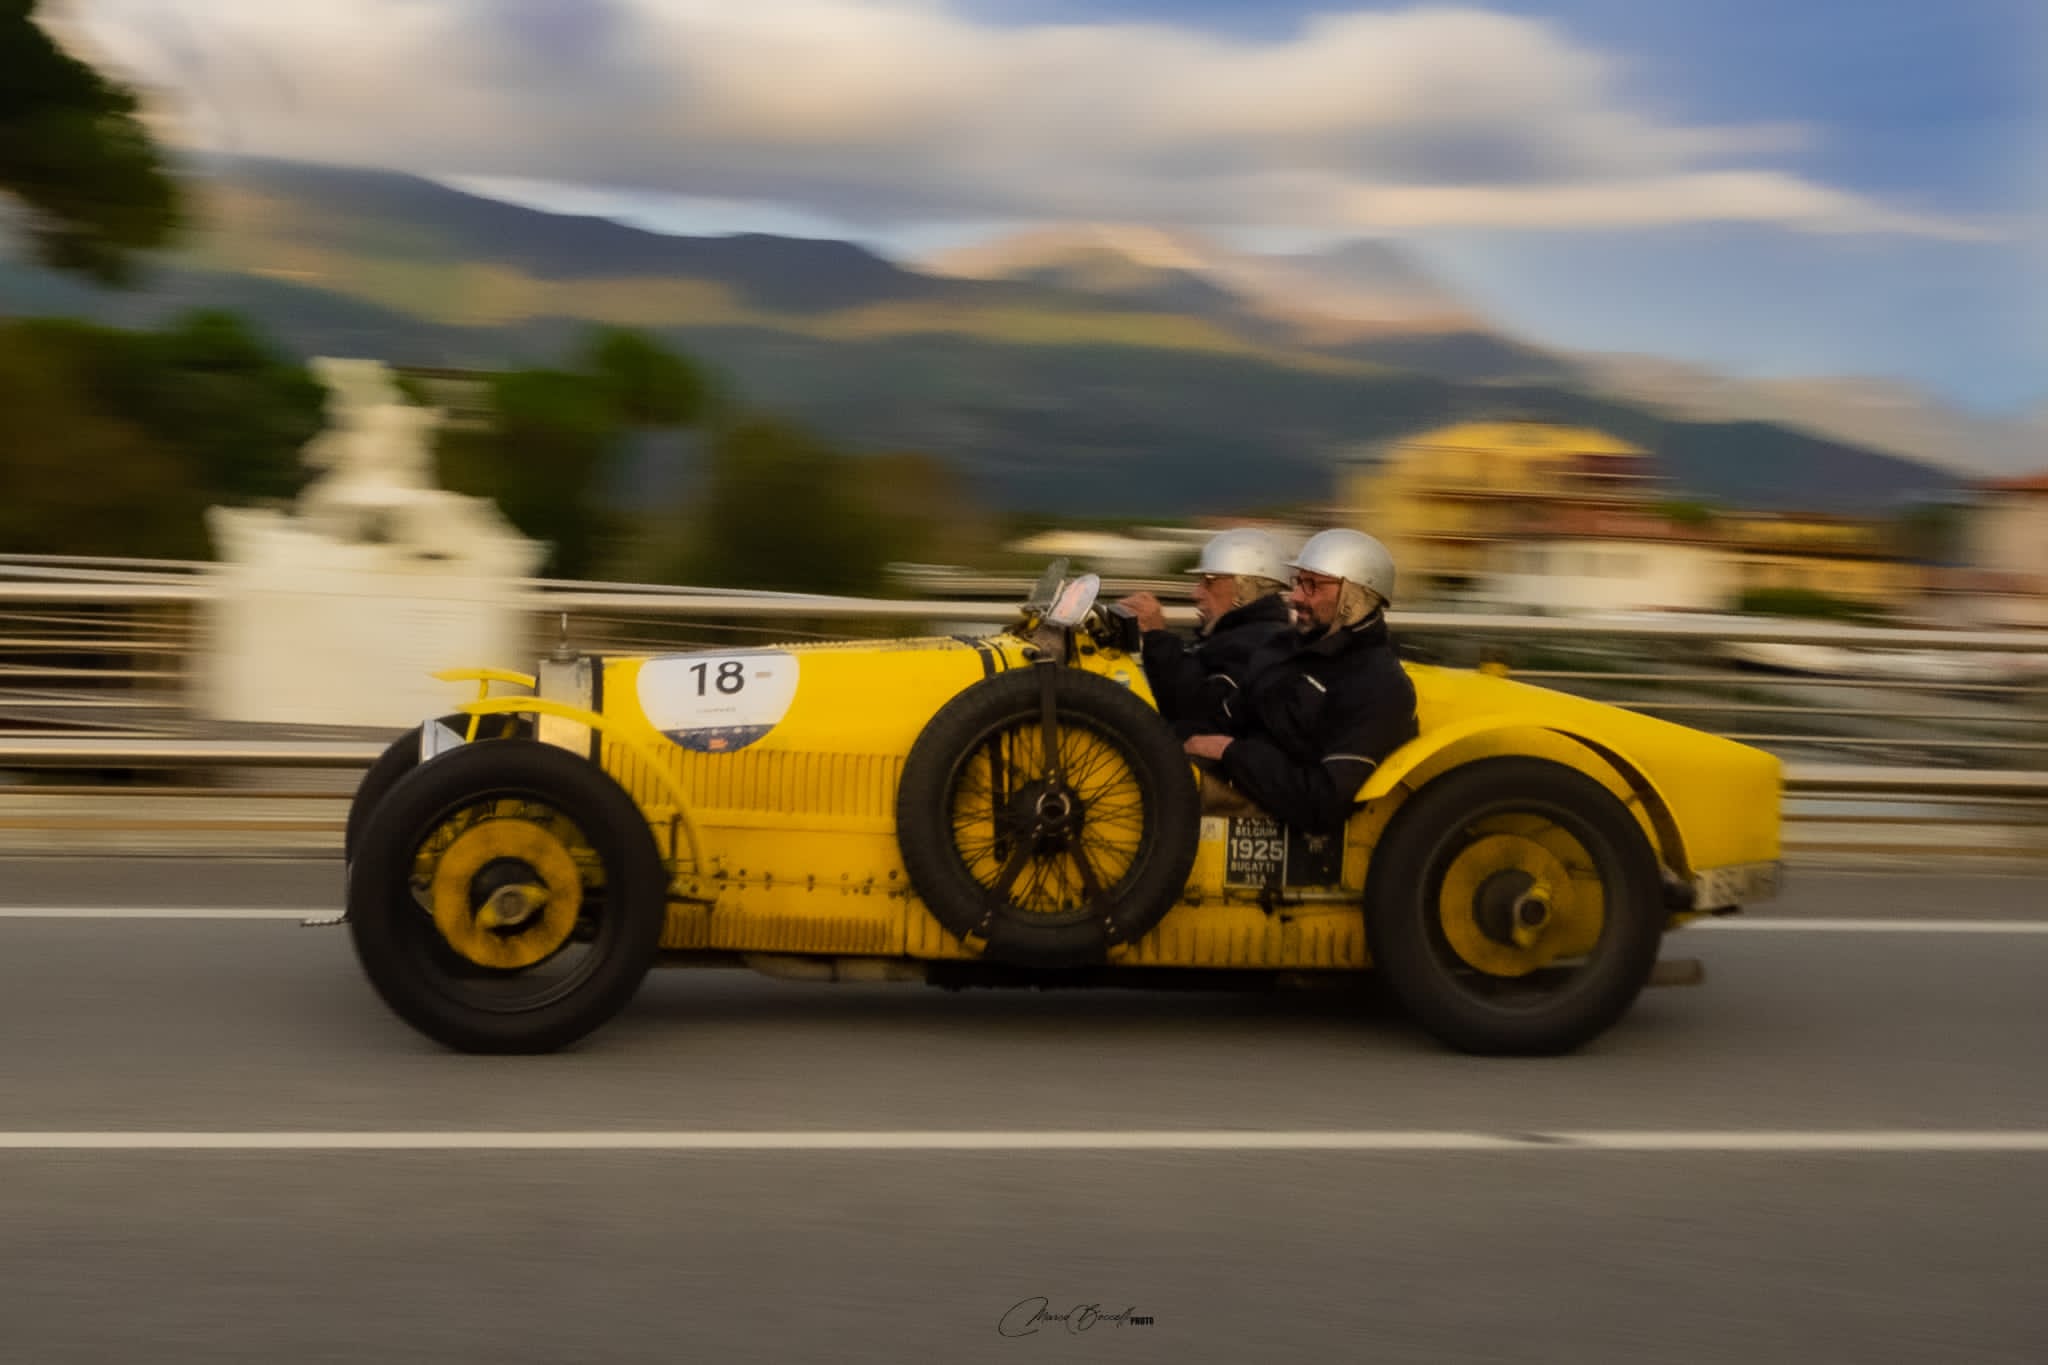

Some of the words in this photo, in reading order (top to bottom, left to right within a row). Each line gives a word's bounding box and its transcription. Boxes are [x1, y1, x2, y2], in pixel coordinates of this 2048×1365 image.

[689, 661, 745, 696] 18
[1230, 839, 1283, 861] 1925
[1230, 862, 1275, 873] BUGATTI
